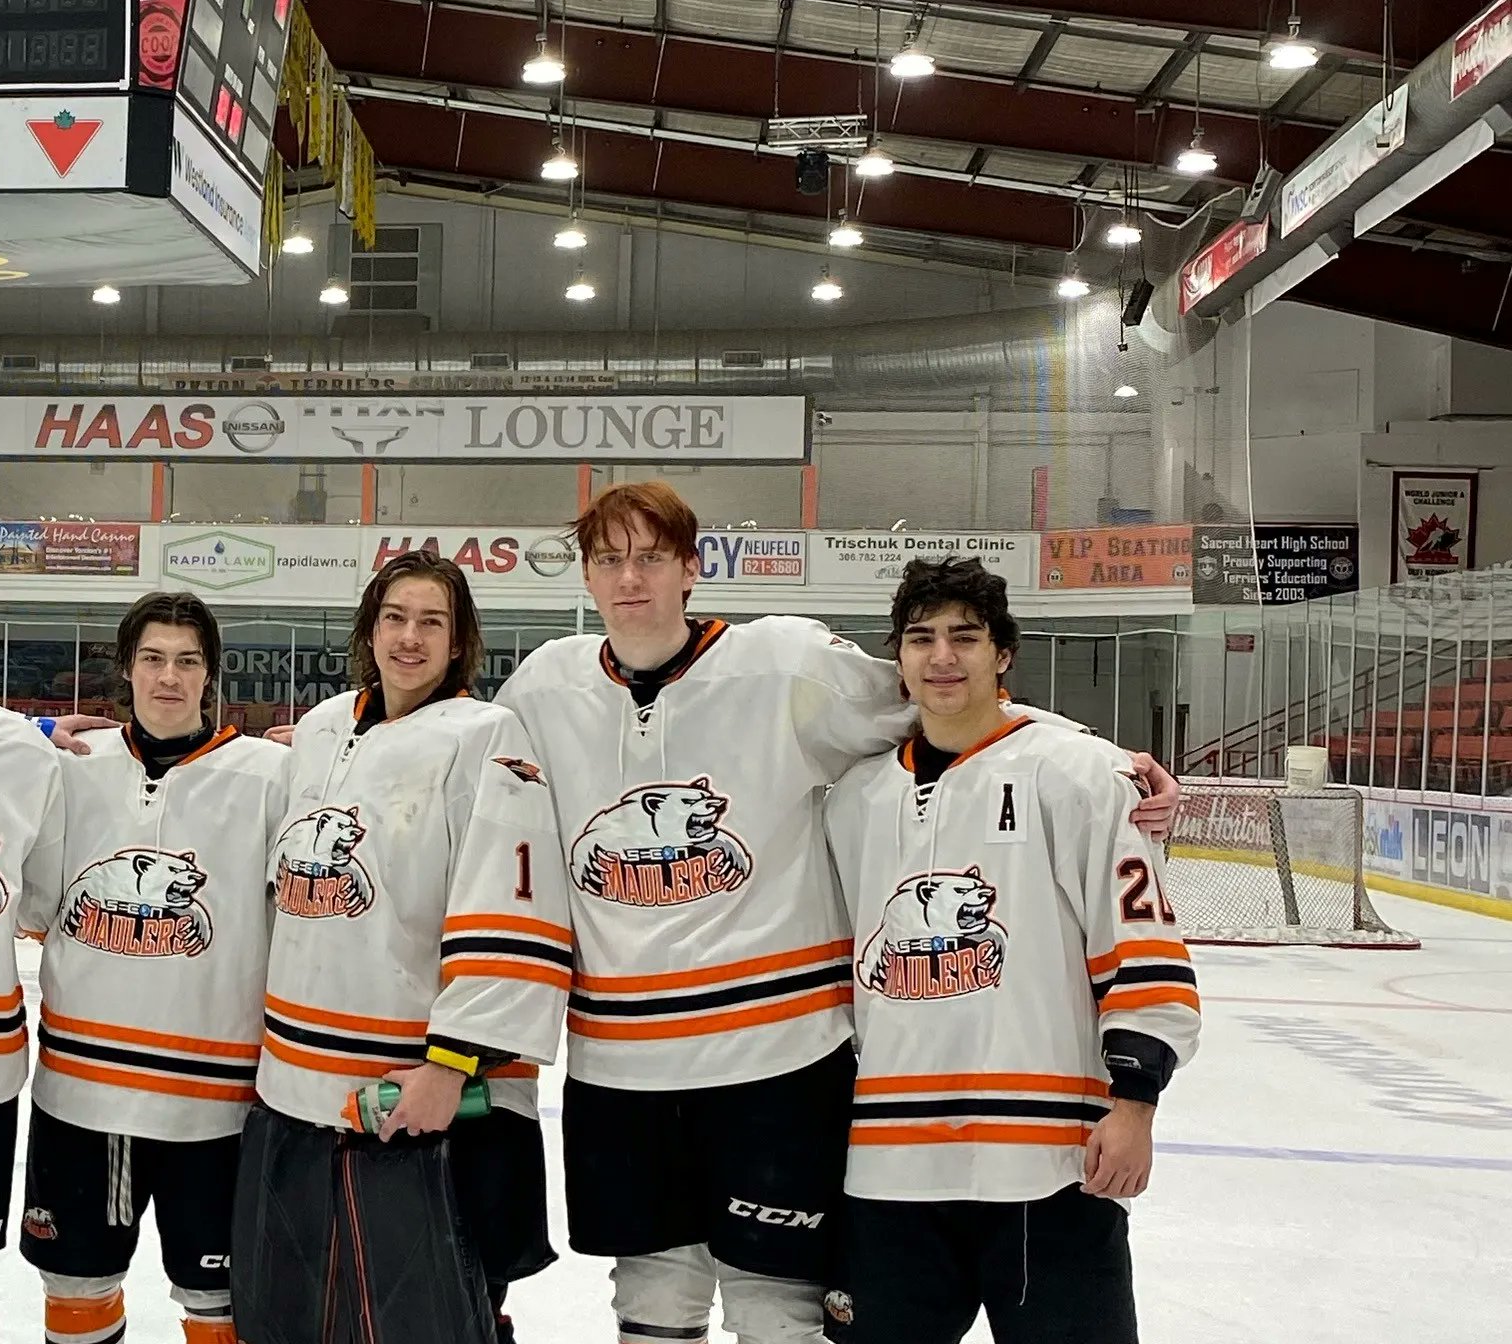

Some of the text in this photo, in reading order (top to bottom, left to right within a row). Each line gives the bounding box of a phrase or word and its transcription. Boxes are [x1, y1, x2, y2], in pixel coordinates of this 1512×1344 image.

[34, 402, 217, 449] HAAS
[226, 421, 281, 432] NISSAN
[463, 403, 726, 451] LOUNGE
[0, 526, 136, 543] Painted Hand Casino
[824, 537, 1015, 551] Trischuk Dental Clinic
[1200, 535, 1242, 550] Sacred
[1281, 536, 1307, 553] High
[1310, 537, 1350, 550] School
[371, 536, 519, 573] HAAS
[526, 551, 575, 562] NISSAN
[744, 538, 800, 557] NEUFELD
[1047, 537, 1093, 559] VIP
[169, 555, 266, 567] RAPID LAWN
[277, 555, 357, 570] rapidlawn.ca
[743, 560, 800, 575] 621-3680
[1266, 555, 1327, 572] Supporting
[1090, 563, 1145, 583] AREA
[1275, 572, 1328, 585] Education
[998, 782, 1016, 832] A
[1413, 816, 1490, 884] LEON
[515, 840, 533, 903] 1
[598, 847, 725, 906] MAULERS
[76, 898, 192, 956] MAULERS
[728, 1197, 825, 1230] CCM
